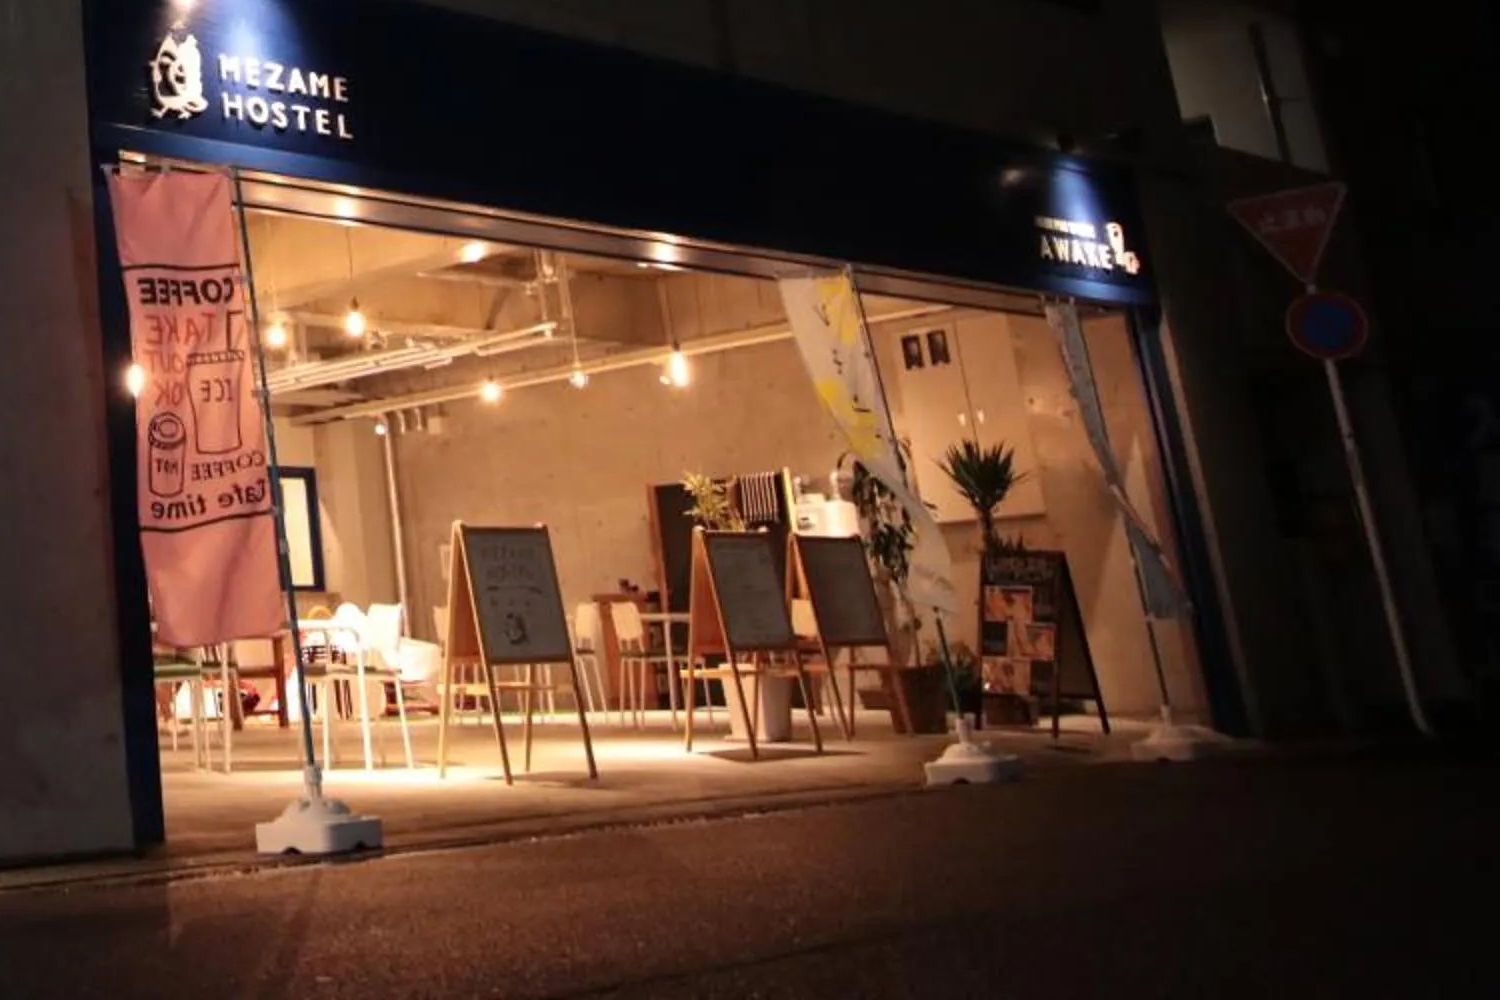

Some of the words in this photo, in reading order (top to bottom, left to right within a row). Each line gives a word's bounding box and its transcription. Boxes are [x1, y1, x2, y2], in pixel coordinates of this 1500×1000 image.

[218, 53, 350, 102] MEZAME
[220, 91, 354, 140] HOSTEL
[1040, 235, 1113, 270] AWAKE
